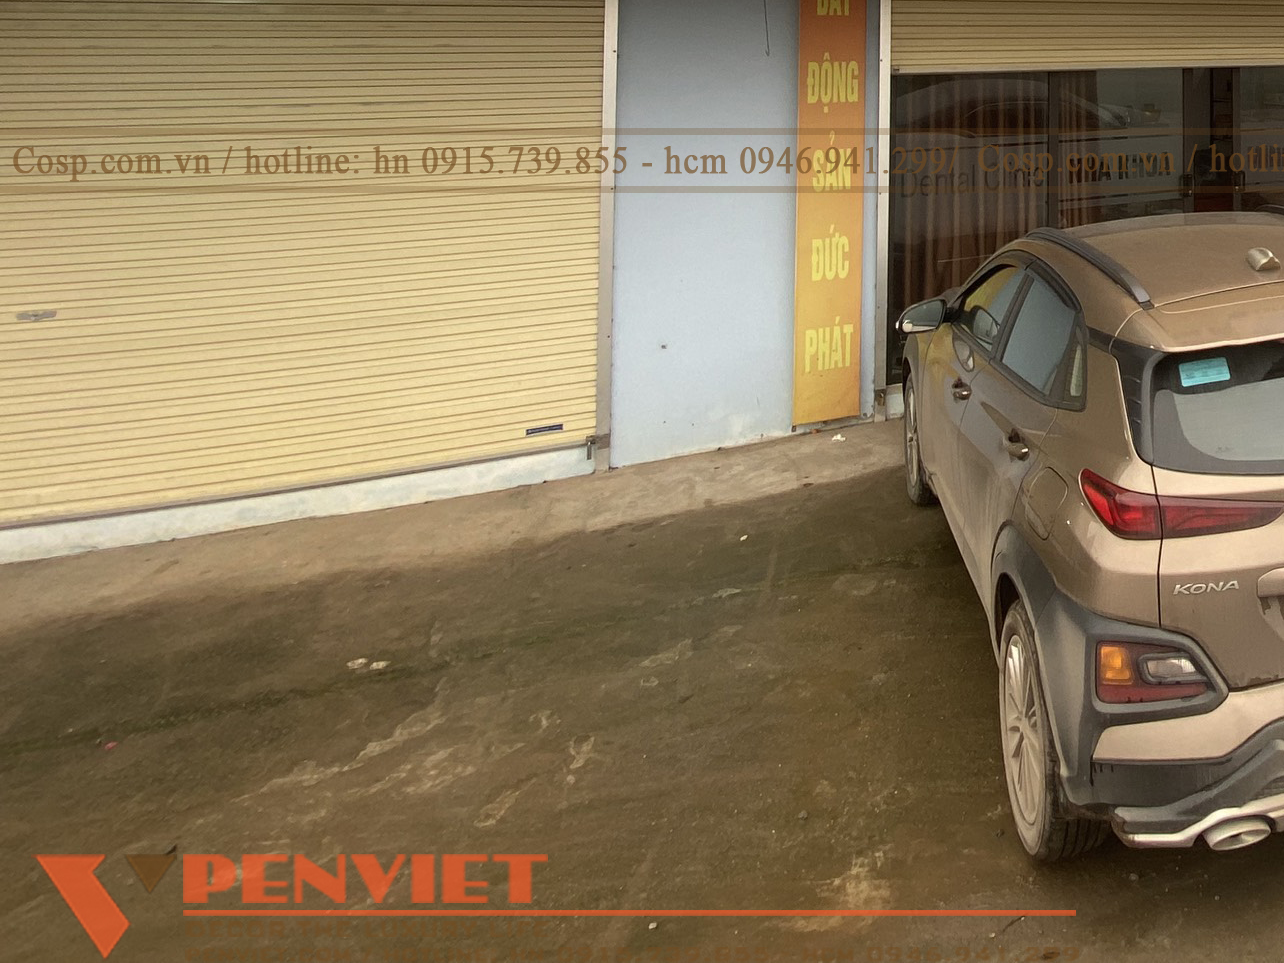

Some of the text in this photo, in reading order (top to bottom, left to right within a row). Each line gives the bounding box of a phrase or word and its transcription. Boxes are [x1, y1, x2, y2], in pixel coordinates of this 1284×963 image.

[806, 57, 859, 113] ĐỘNG
[812, 130, 851, 191] SẢN
[811, 226, 850, 280] ĐỨC
[804, 319, 853, 375] PHÁT
[1172, 579, 1240, 596] KONA
